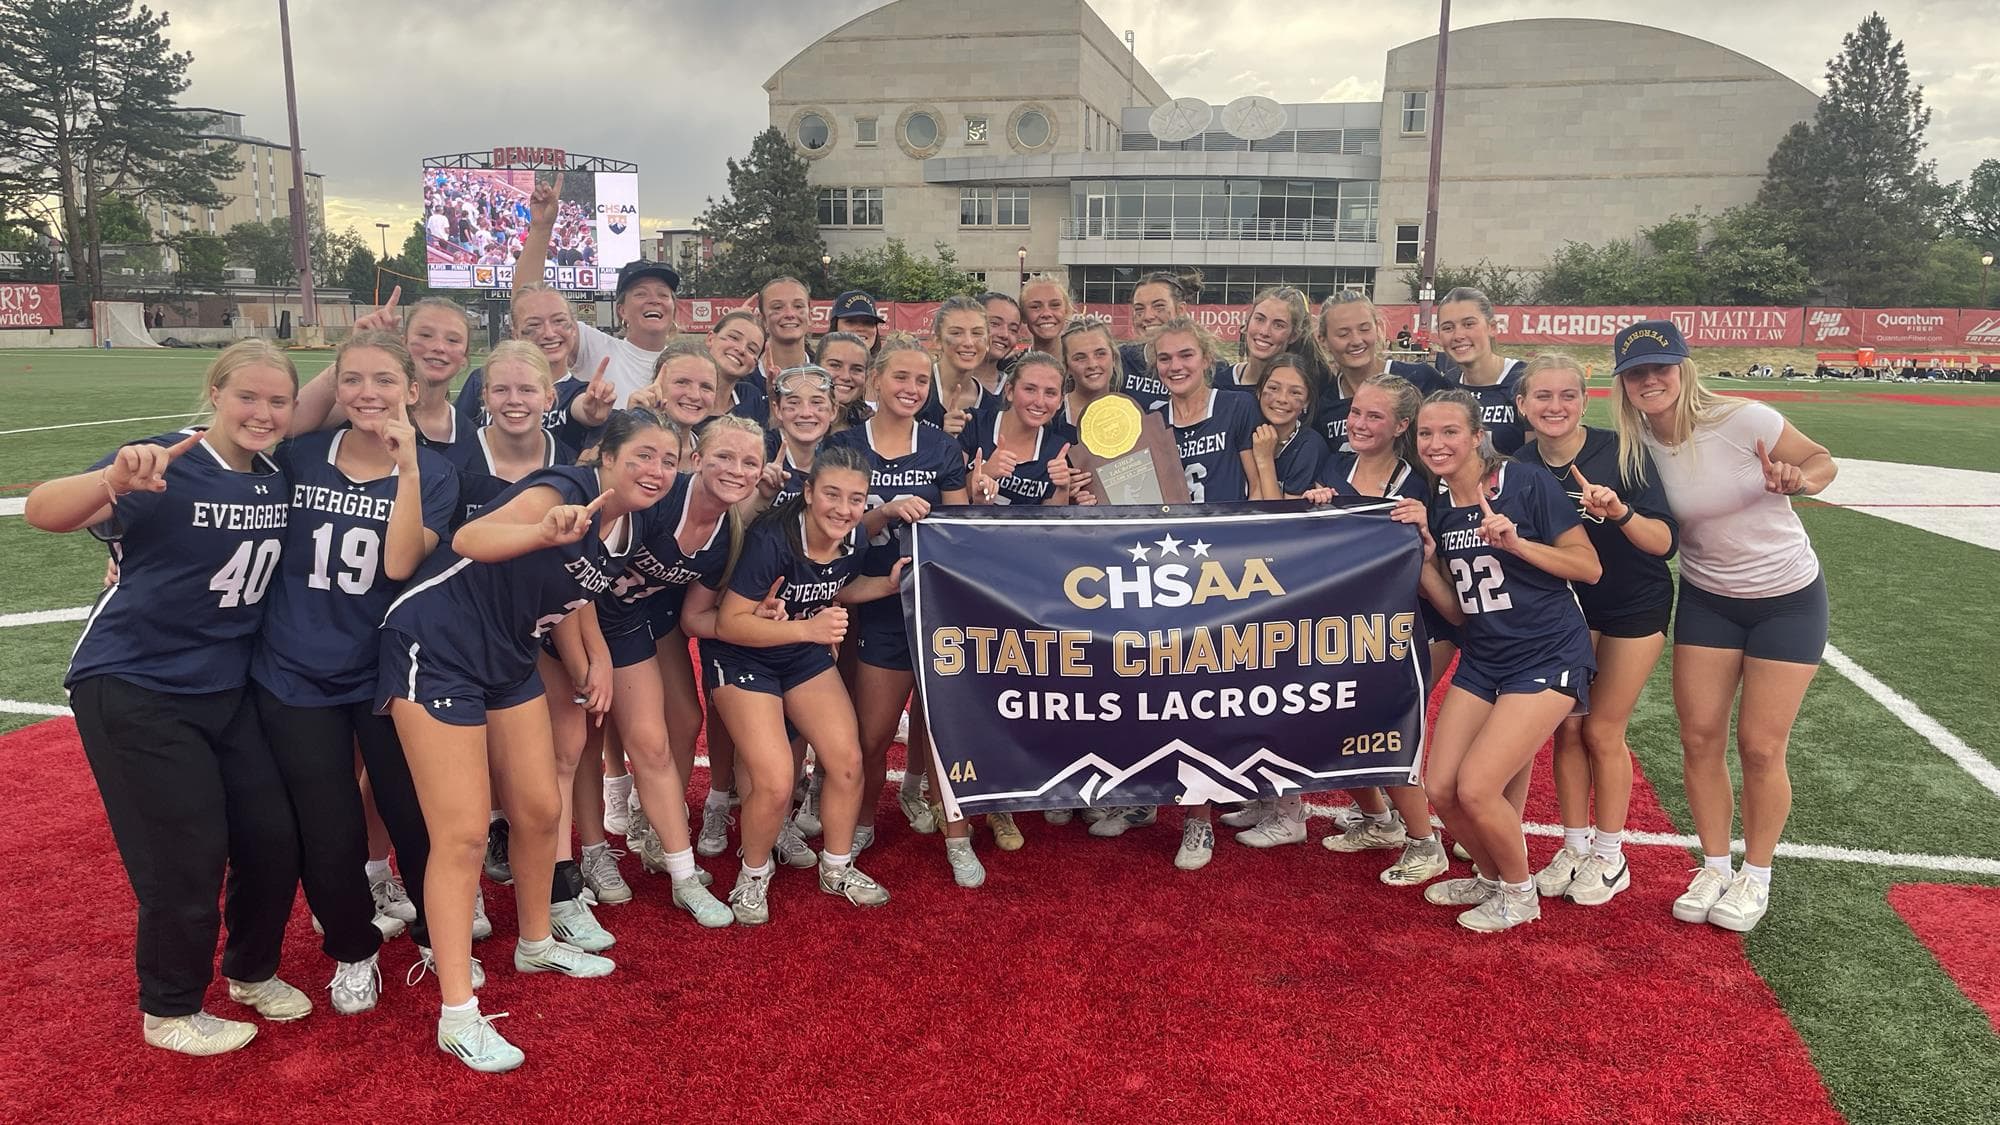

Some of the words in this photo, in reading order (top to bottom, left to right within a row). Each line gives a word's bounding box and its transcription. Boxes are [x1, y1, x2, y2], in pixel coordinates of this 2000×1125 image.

[493, 147, 566, 168] DENVER
[597, 204, 637, 214] CHSAA
[499, 269, 512, 279] 12
[560, 271, 572, 279] 11
[579, 269, 593, 286] G
[0, 286, 41, 311] RF'S
[0, 309, 43, 325] wiches
[1699, 311, 1788, 327] MATLIN
[1877, 313, 1944, 328] Quantum
[1699, 328, 1751, 341] INJURY
[1755, 328, 1786, 340] LAW
[1815, 326, 1850, 342] you
[1126, 374, 1172, 395] EVERG
[1176, 431, 1226, 459] GREEN
[292, 483, 394, 523] EVERGRE
[192, 501, 289, 531] EVERGREE
[307, 522, 381, 596] 19
[208, 538, 282, 609] 40
[1063, 557, 1286, 610] CHSAA
[1449, 554, 1513, 615] 22
[932, 625, 1094, 678] STATE
[1112, 611, 1416, 678] CHAMPIONS
[996, 688, 1122, 722] GIRLS
[1138, 679, 1359, 722] LACROSSE
[1340, 729, 1403, 756] 2026
[949, 760, 978, 784] 4A
